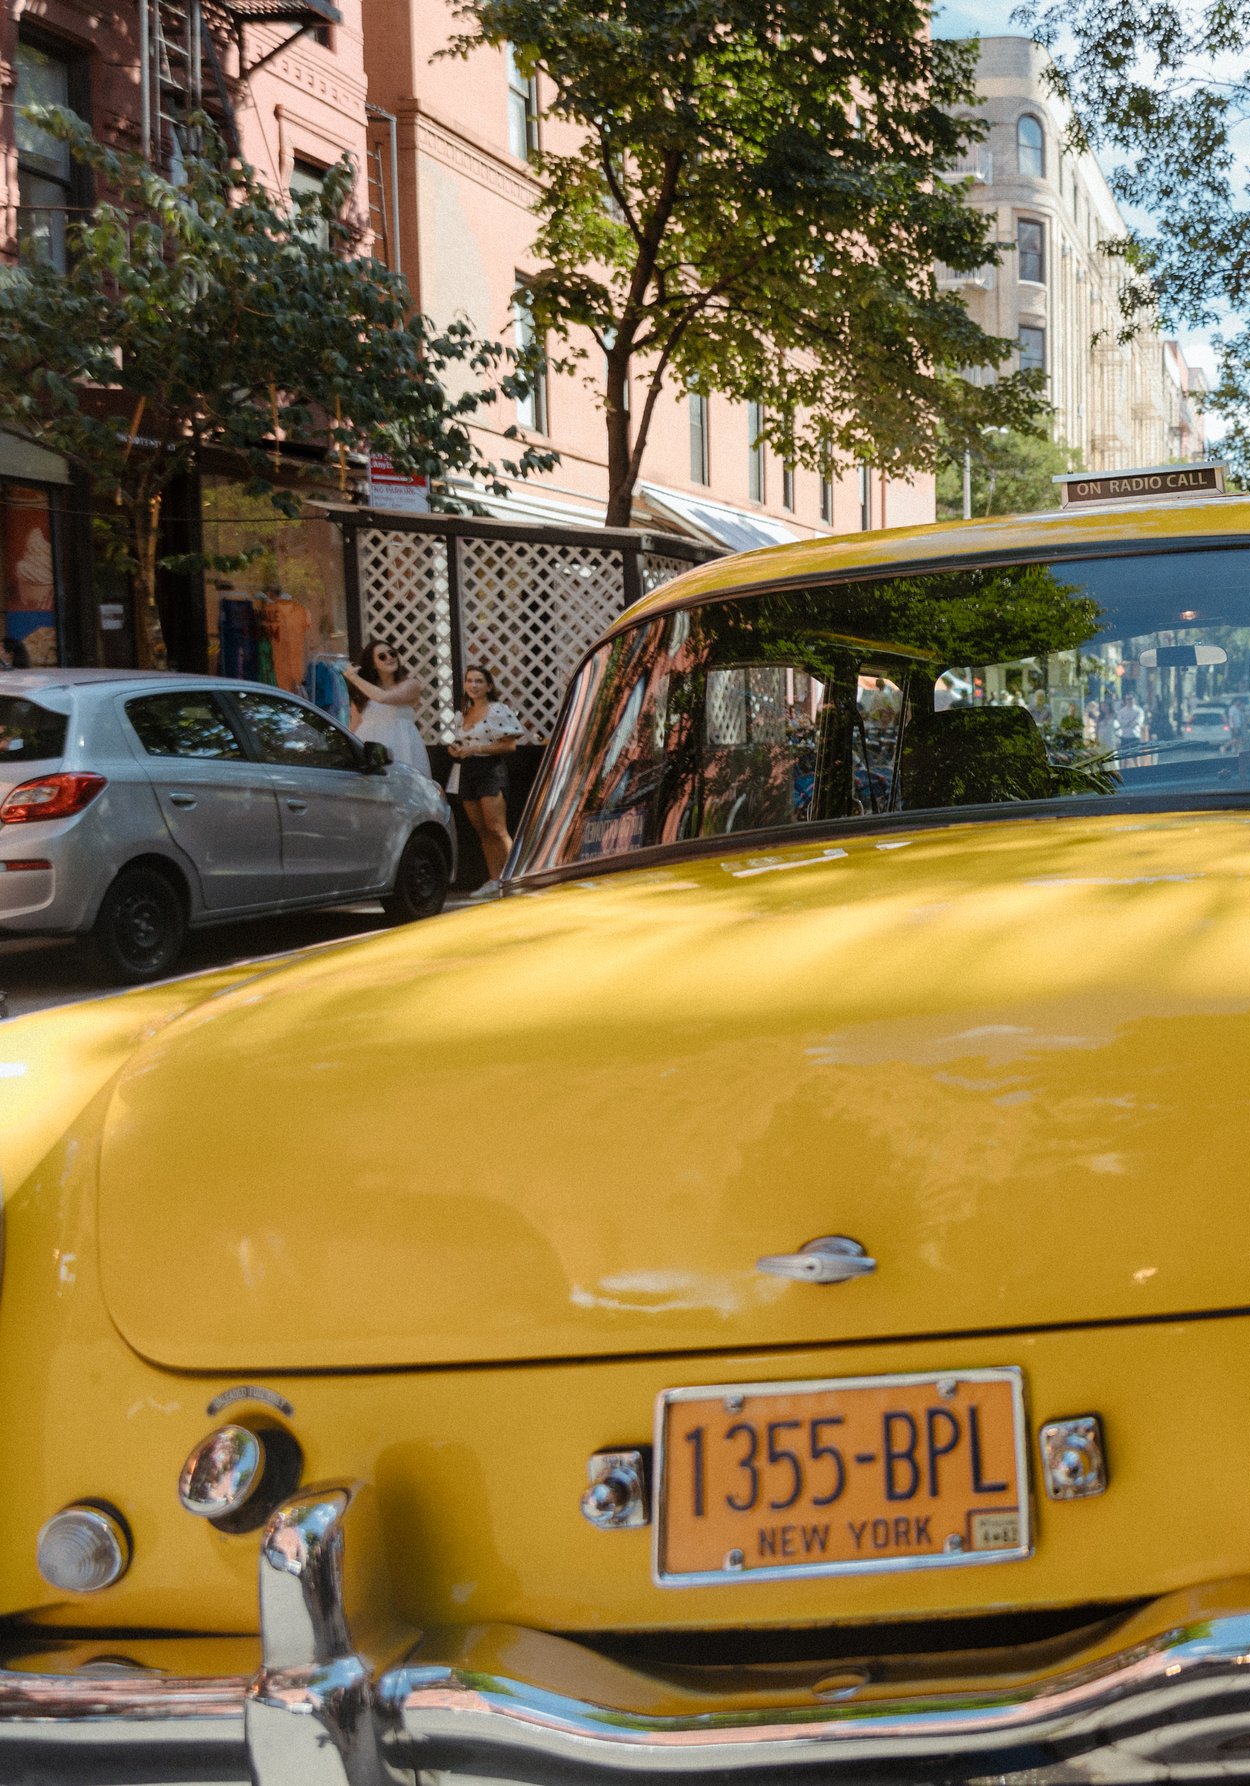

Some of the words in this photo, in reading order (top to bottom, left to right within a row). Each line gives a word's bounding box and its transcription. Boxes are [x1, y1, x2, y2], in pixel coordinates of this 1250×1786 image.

[1077, 482, 1102, 495] ON
[1109, 476, 1162, 493] RADIO
[1166, 472, 1207, 488] CALL
[685, 1405, 1008, 1517] 1355-BPL
[758, 1523, 831, 1557] NEW
[847, 1515, 932, 1550] YORK
